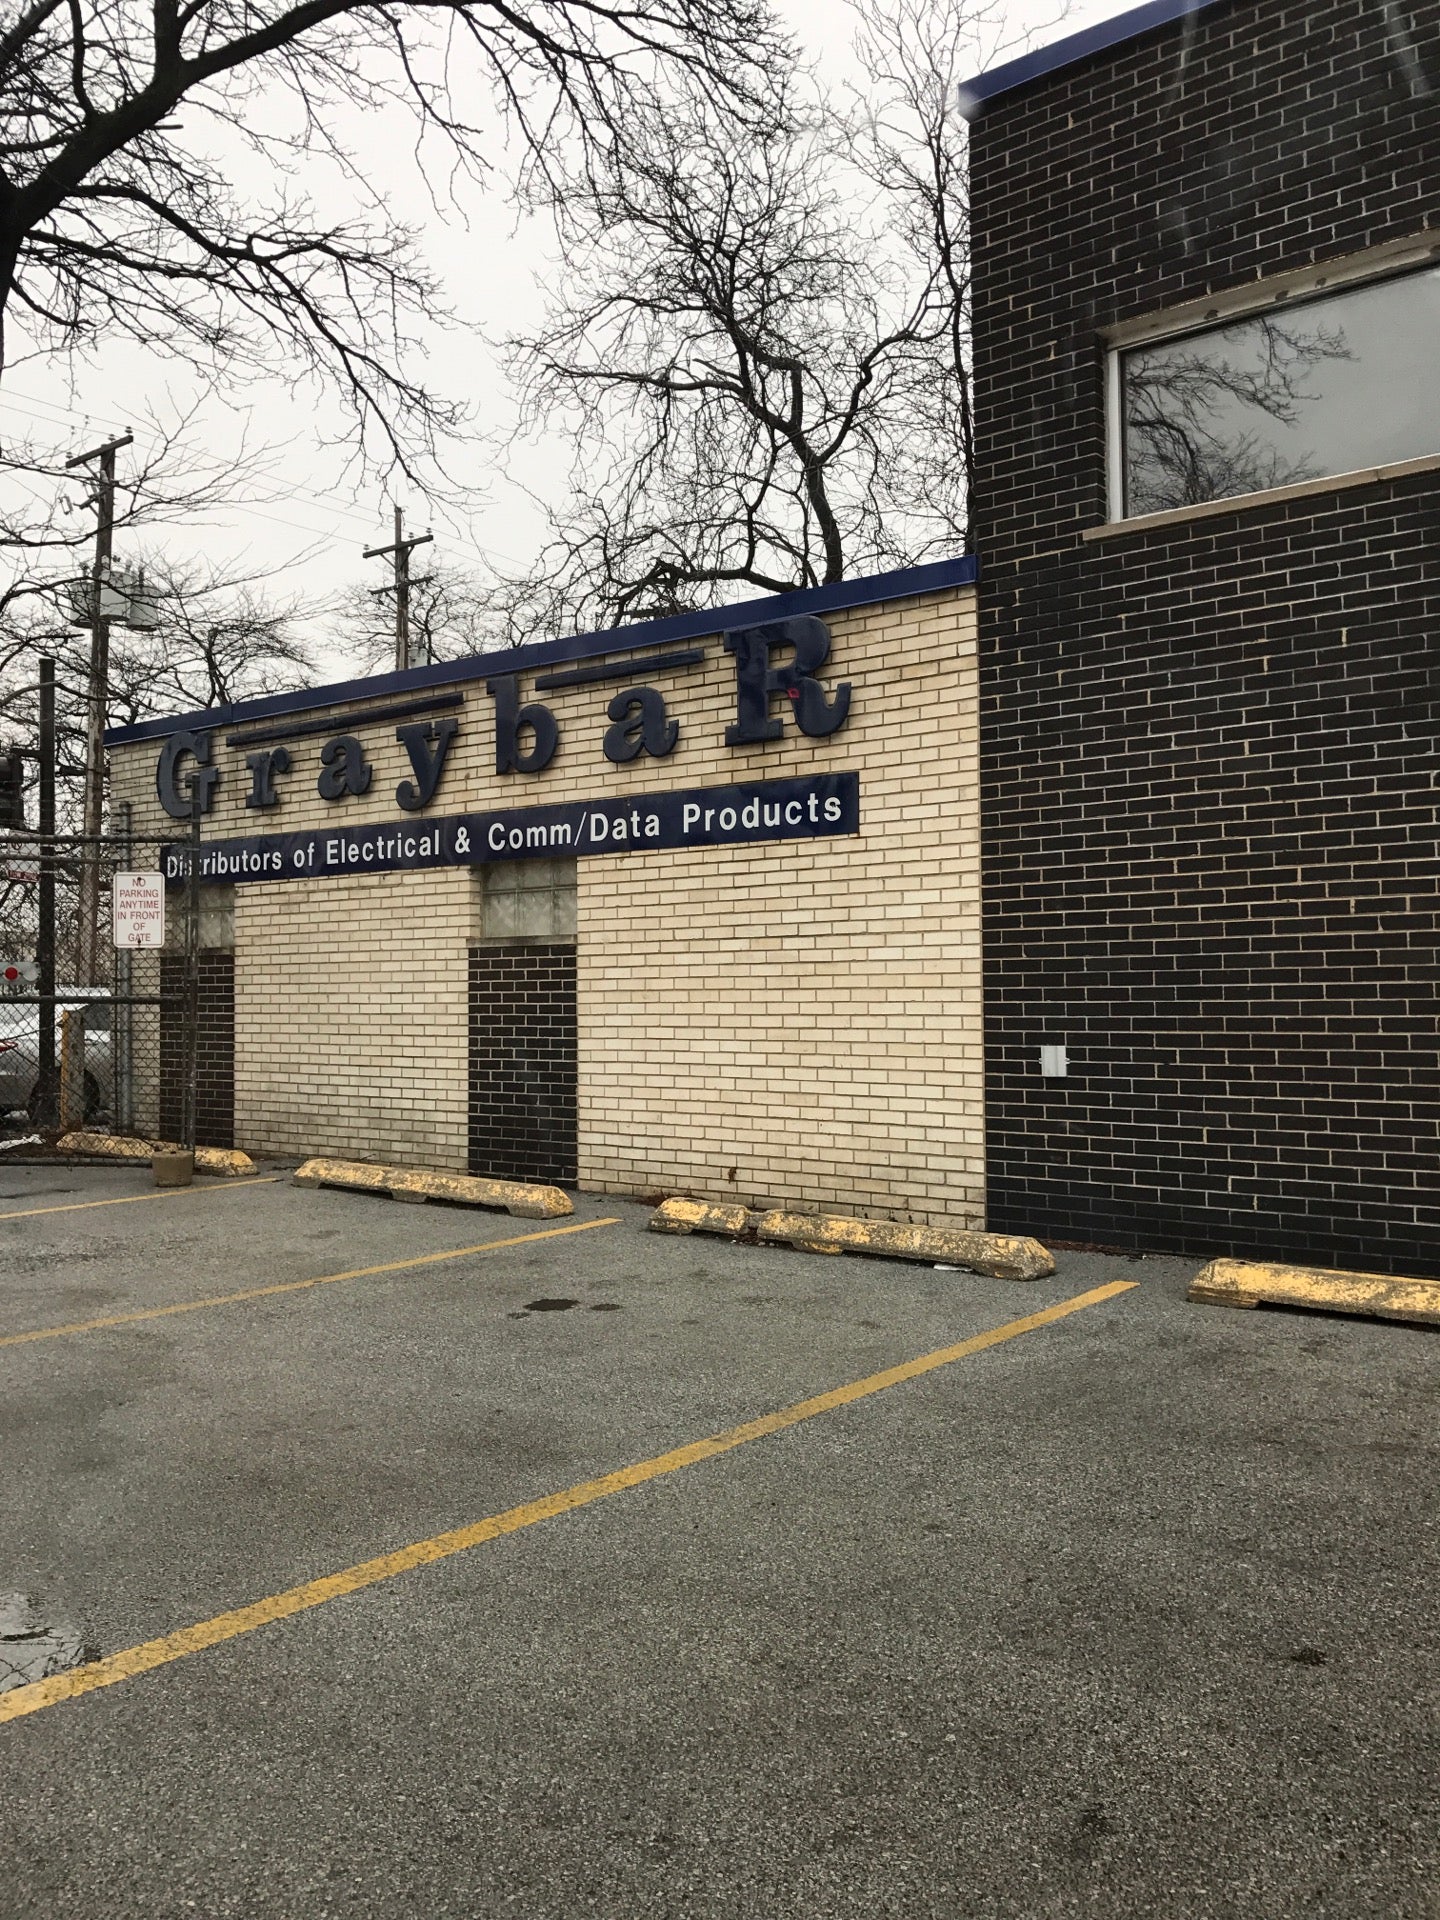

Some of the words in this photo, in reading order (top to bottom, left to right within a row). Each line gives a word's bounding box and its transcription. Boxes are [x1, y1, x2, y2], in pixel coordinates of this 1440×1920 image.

[167, 850, 282, 878] Disributors
[293, 846, 314, 869] of
[326, 829, 440, 866] Electrical
[455, 826, 471, 854] &
[488, 811, 660, 851] Comm/Data
[683, 792, 843, 833] Products
[132, 878, 146, 887] NO
[120, 889, 159, 898] PARKING
[130, 911, 160, 920] FRONT
[132, 922, 146, 930] OF
[128, 933, 150, 942] GATE
